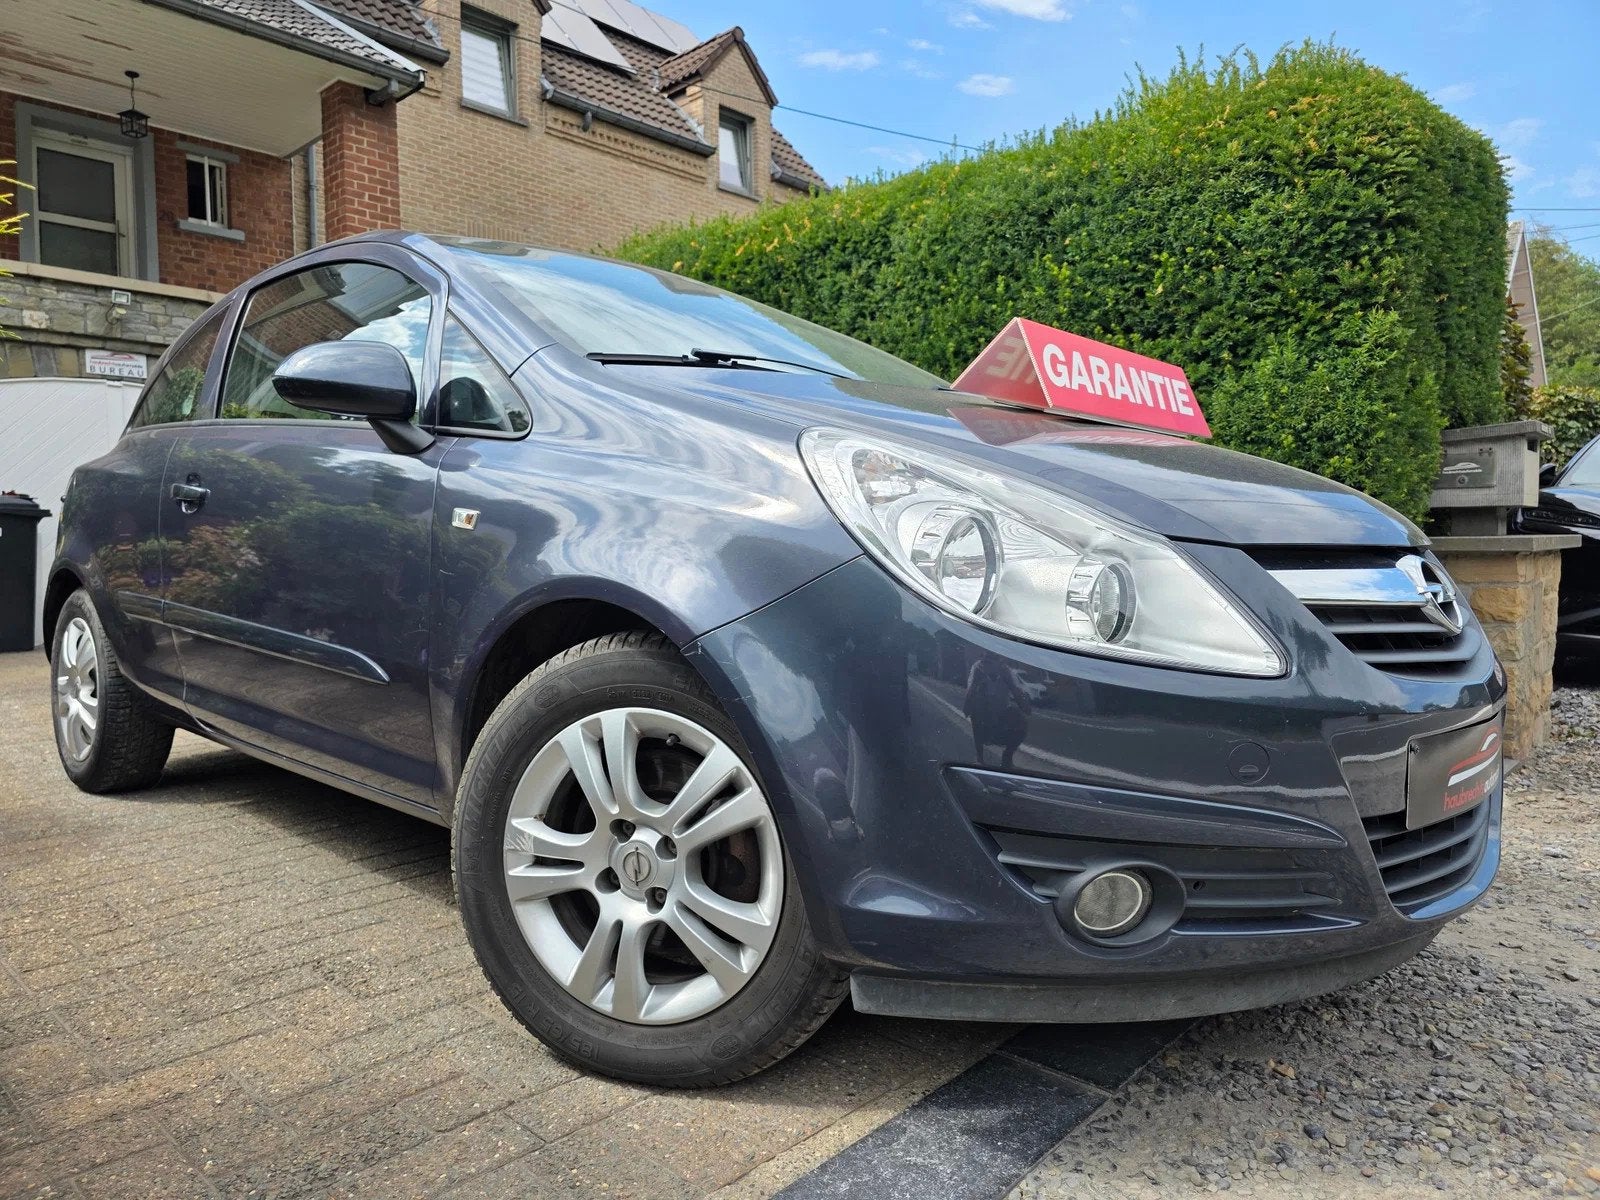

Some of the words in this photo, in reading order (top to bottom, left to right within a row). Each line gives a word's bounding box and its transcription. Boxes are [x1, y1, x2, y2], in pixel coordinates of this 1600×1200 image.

[89, 365, 144, 377] BUREAU
[1042, 343, 1194, 416] GARANTIE
[464, 700, 530, 833] MICHELIN
